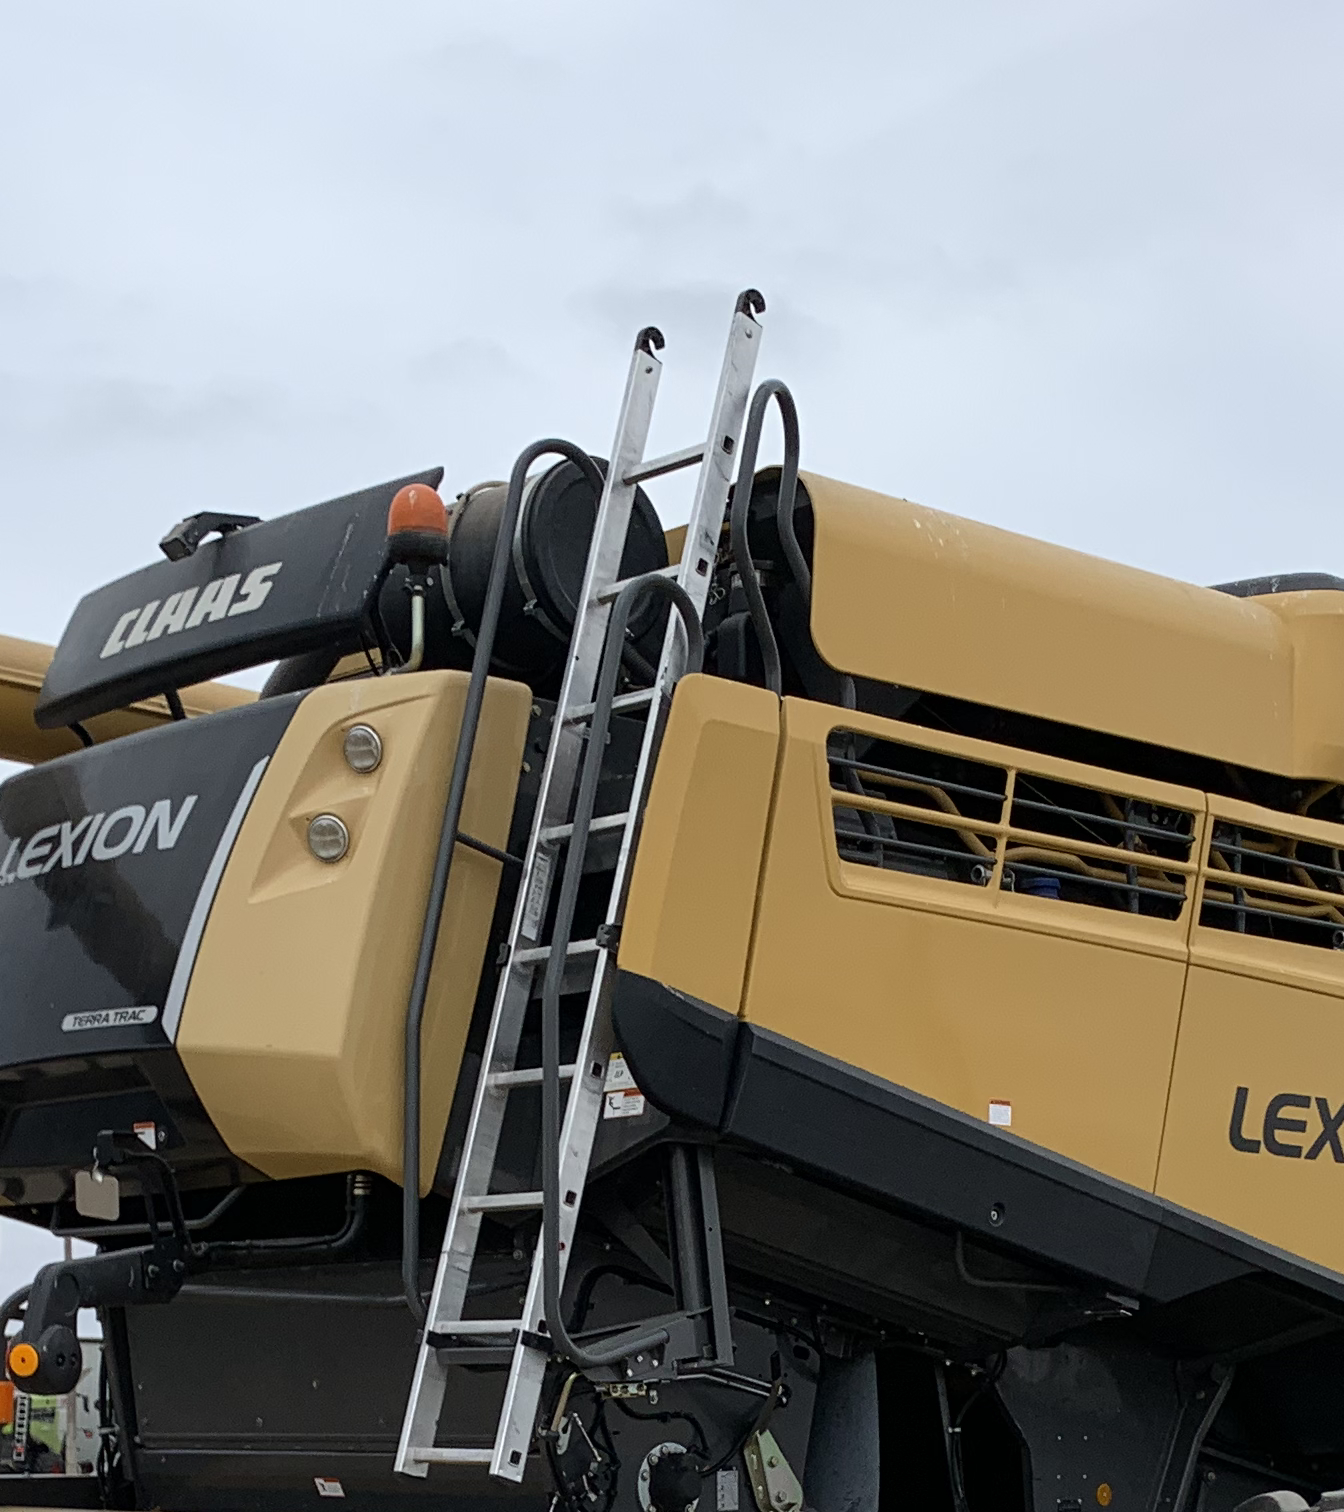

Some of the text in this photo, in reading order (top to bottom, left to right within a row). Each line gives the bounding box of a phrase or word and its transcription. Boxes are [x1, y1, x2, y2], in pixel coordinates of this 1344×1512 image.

[99, 561, 283, 660] CLAAS
[72, 1009, 146, 1028] TERRA TRAC
